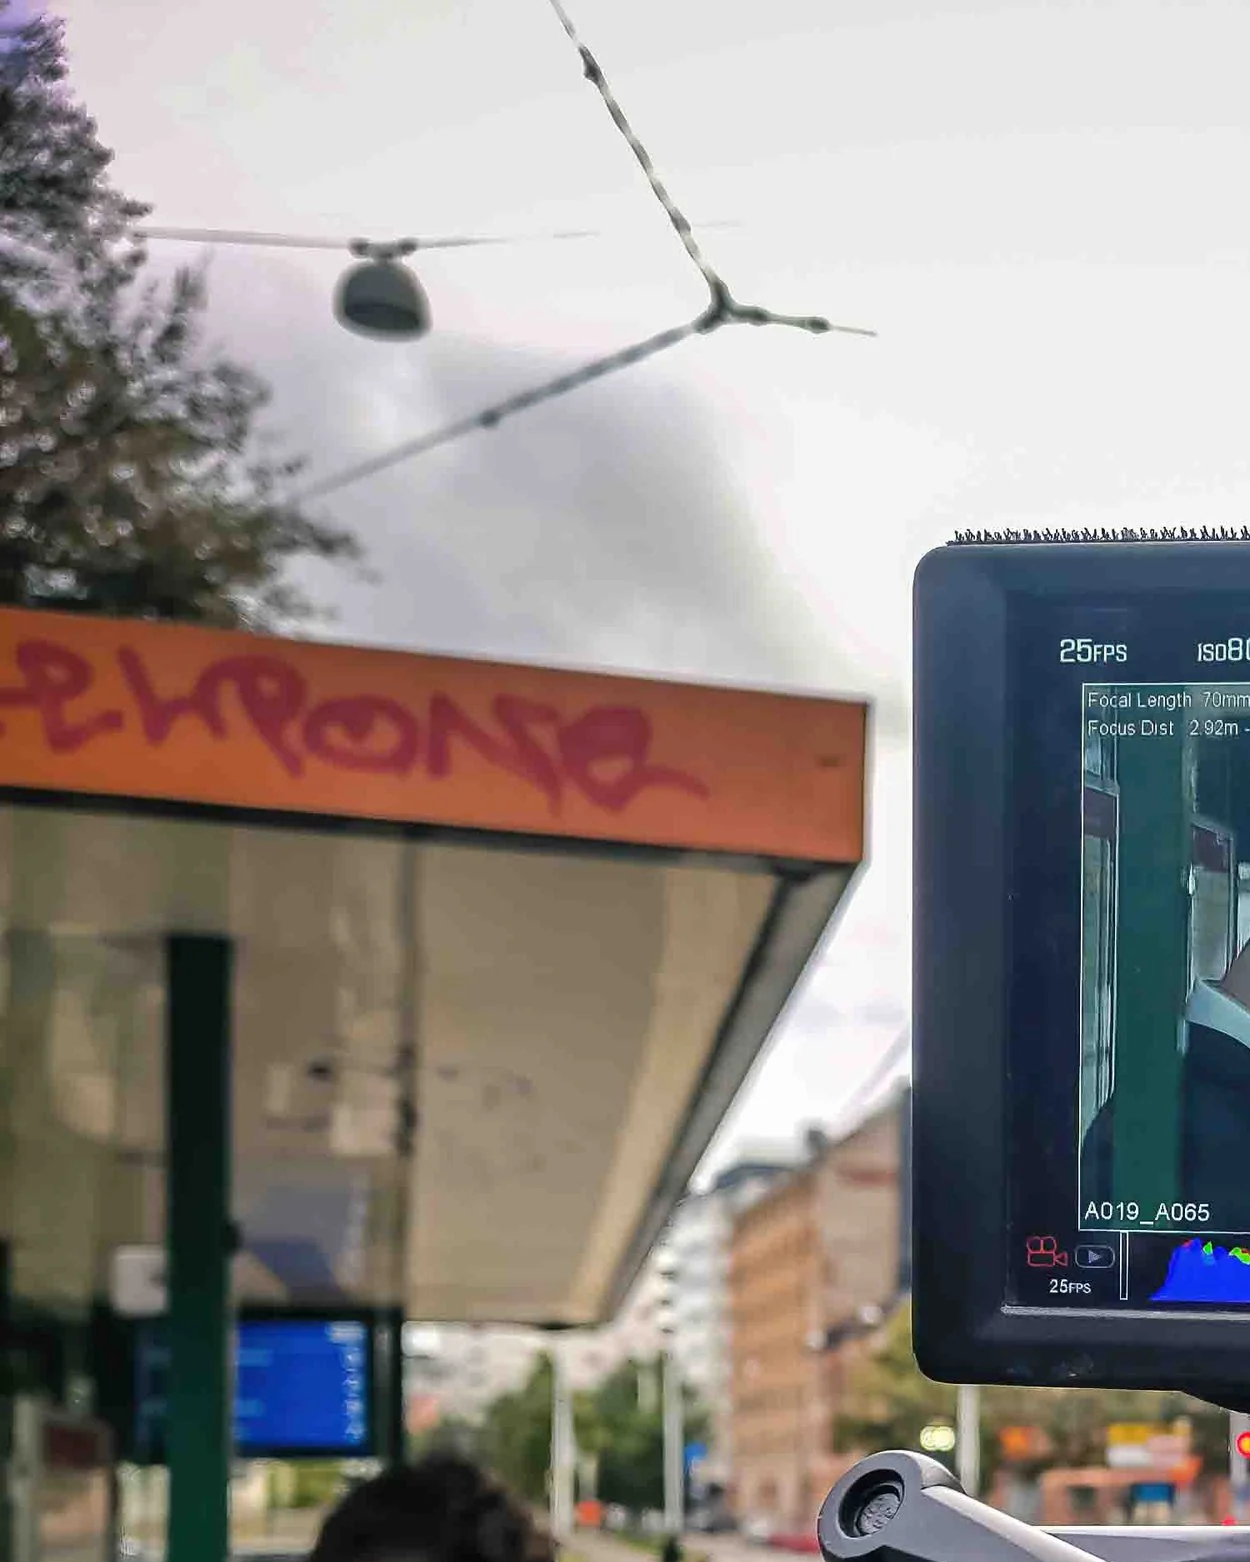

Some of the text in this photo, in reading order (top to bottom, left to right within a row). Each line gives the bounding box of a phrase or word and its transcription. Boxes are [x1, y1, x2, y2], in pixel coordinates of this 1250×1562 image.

[1059, 637, 1128, 664] 25FPS
[1088, 690, 1132, 709] Focal
[1137, 691, 1193, 712] Length
[1088, 718, 1137, 737] Focus
[1084, 1201, 1211, 1227] A019_A065
[1049, 1278, 1092, 1295] 25FPS
